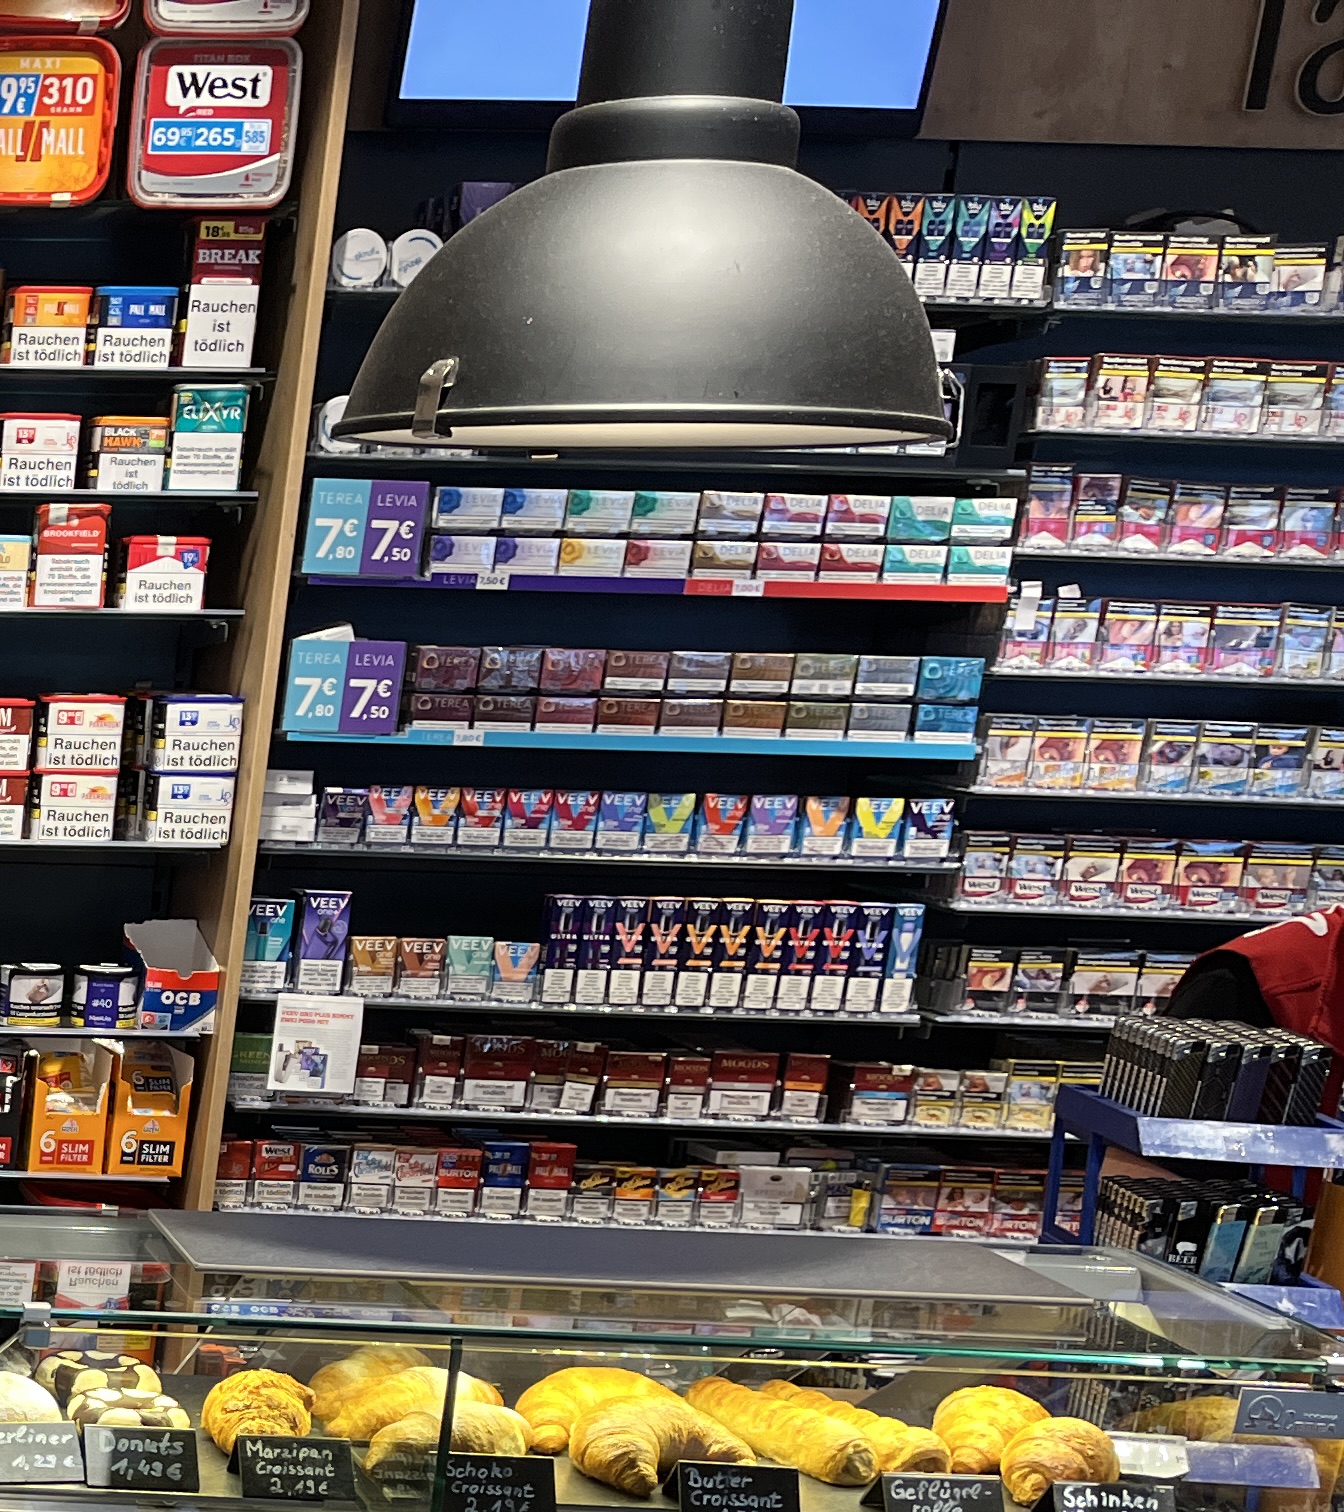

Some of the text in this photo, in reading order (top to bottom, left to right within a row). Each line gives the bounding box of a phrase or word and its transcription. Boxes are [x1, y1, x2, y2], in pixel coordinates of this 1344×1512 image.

[20, 58, 61, 69] MAXI
[43, 77, 94, 106] 310
[176, 72, 262, 100] West
[41, 127, 85, 155] MALL
[198, 249, 260, 265] BREAK
[191, 300, 257, 314] Rauchen
[212, 319, 230, 333] ist
[17, 334, 80, 347] Rauchen
[103, 335, 166, 348] Rauchen
[194, 339, 245, 353] tödlich
[13, 349, 81, 362] ist tödlich
[98, 350, 167, 363] ist tödlich
[8, 458, 72, 472] Rauchen
[319, 492, 417, 507] TEREA LEVIA
[298, 652, 395, 667] TEREA LEVIA
[310, 896, 349, 910] VEEV
[354, 939, 396, 951] VEEV
[403, 941, 443, 953] VEEV
[451, 938, 492, 951] VEEV
[91, 998, 112, 1009] #40
[161, 991, 201, 1006] OCB
[39, 1130, 89, 1153] 6 SLIM
[120, 1130, 170, 1154] 6 SLIM
[60, 1153, 88, 1163] FILTER
[140, 1154, 170, 1163] FILTER
[881, 1214, 931, 1226] BURTON
[98, 1432, 185, 1455] Donuts
[245, 1439, 334, 1462] Marzipan
[256, 1461, 336, 1478] Croissant
[686, 1466, 753, 1489] Butter
[450, 1480, 535, 1501] Croissant
[690, 1489, 783, 1510] Croissant
[1063, 1486, 1160, 1512] Schinken
